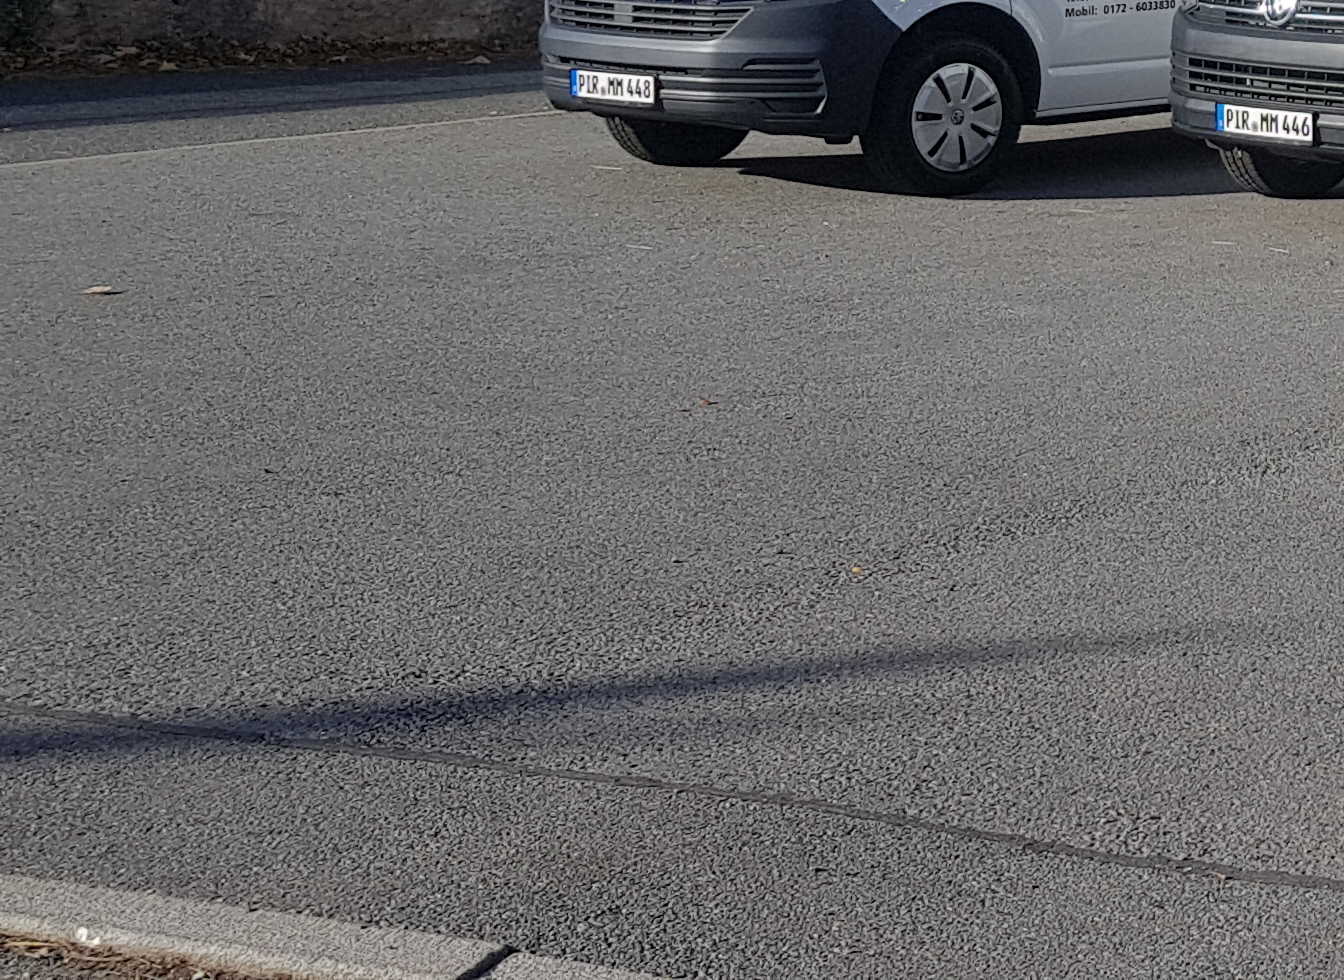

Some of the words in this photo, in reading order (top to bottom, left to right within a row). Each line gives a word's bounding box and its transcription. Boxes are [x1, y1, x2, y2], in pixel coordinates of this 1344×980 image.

[1065, 5, 1098, 18] Mobil:
[1103, 3, 1127, 15] 0172
[608, 77, 623, 96] MM
[627, 79, 651, 98] 448
[1226, 109, 1250, 130] PIR
[1260, 113, 1279, 133] MM
[1283, 115, 1310, 136] 446
